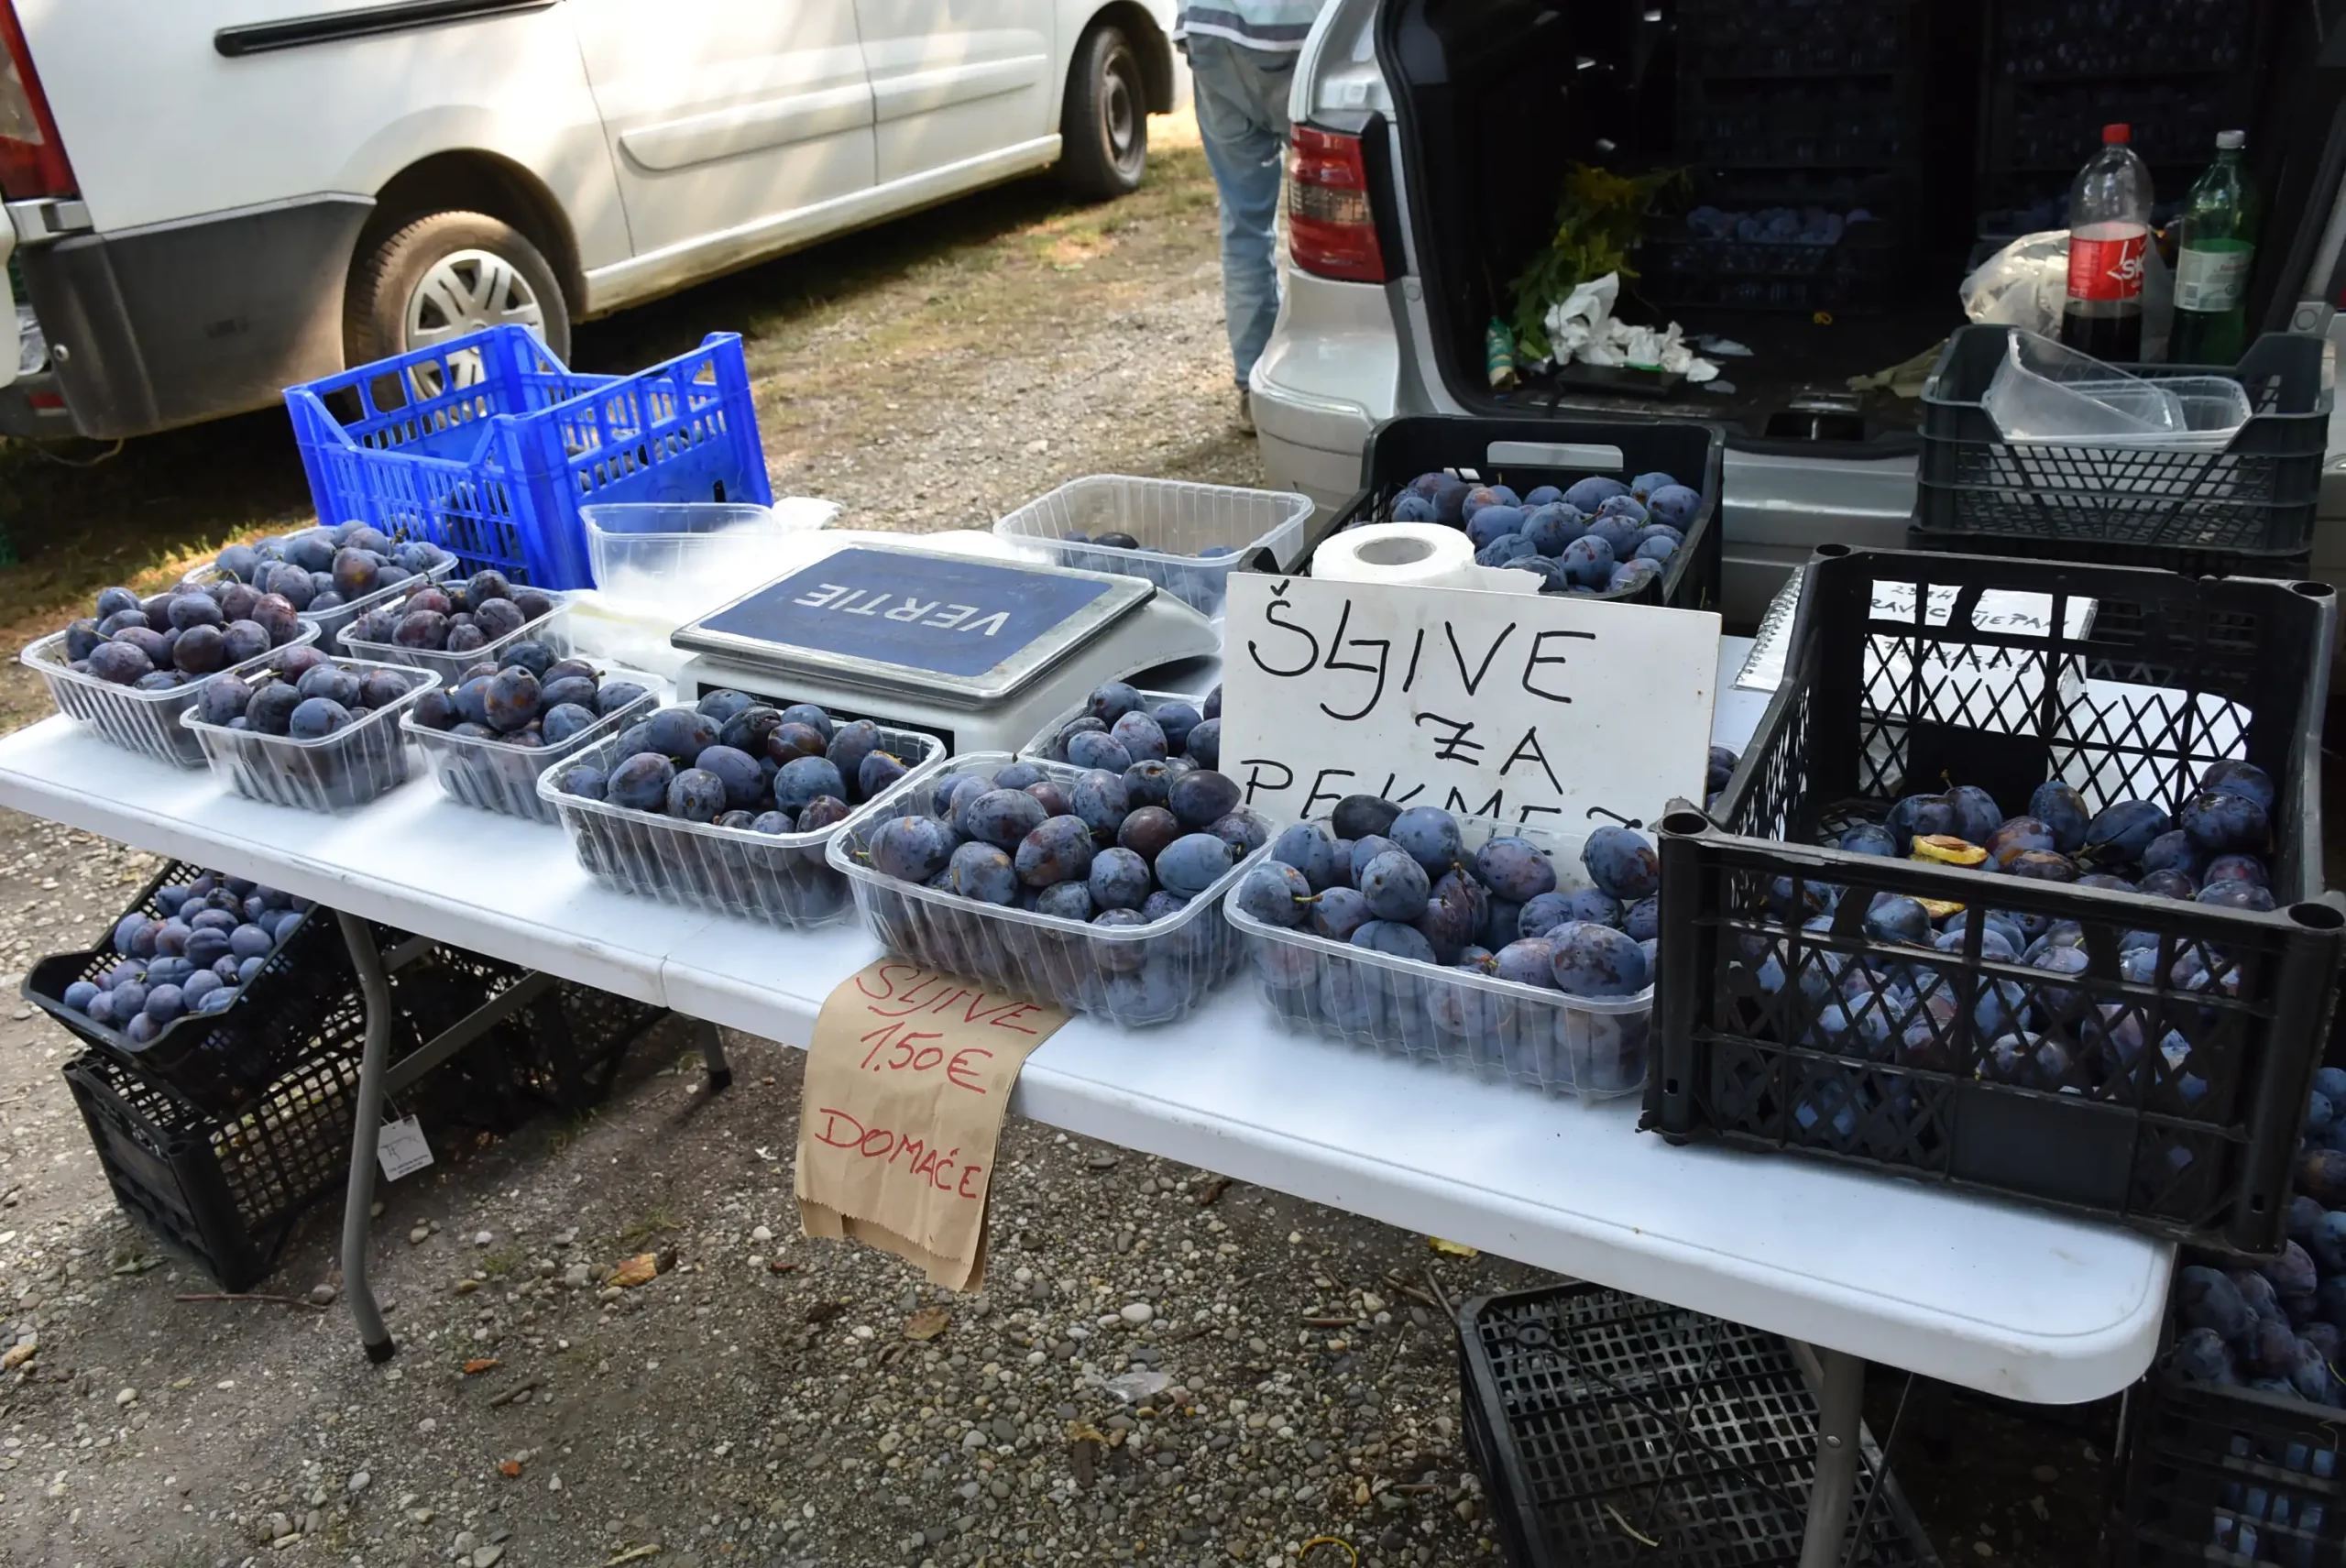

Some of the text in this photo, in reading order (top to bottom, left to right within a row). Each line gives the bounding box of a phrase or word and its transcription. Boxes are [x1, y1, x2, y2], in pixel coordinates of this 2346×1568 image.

[792, 583, 1011, 636] VERTIE
[1415, 712, 1563, 795] ZA
[861, 1021, 993, 1094] 1.50€
